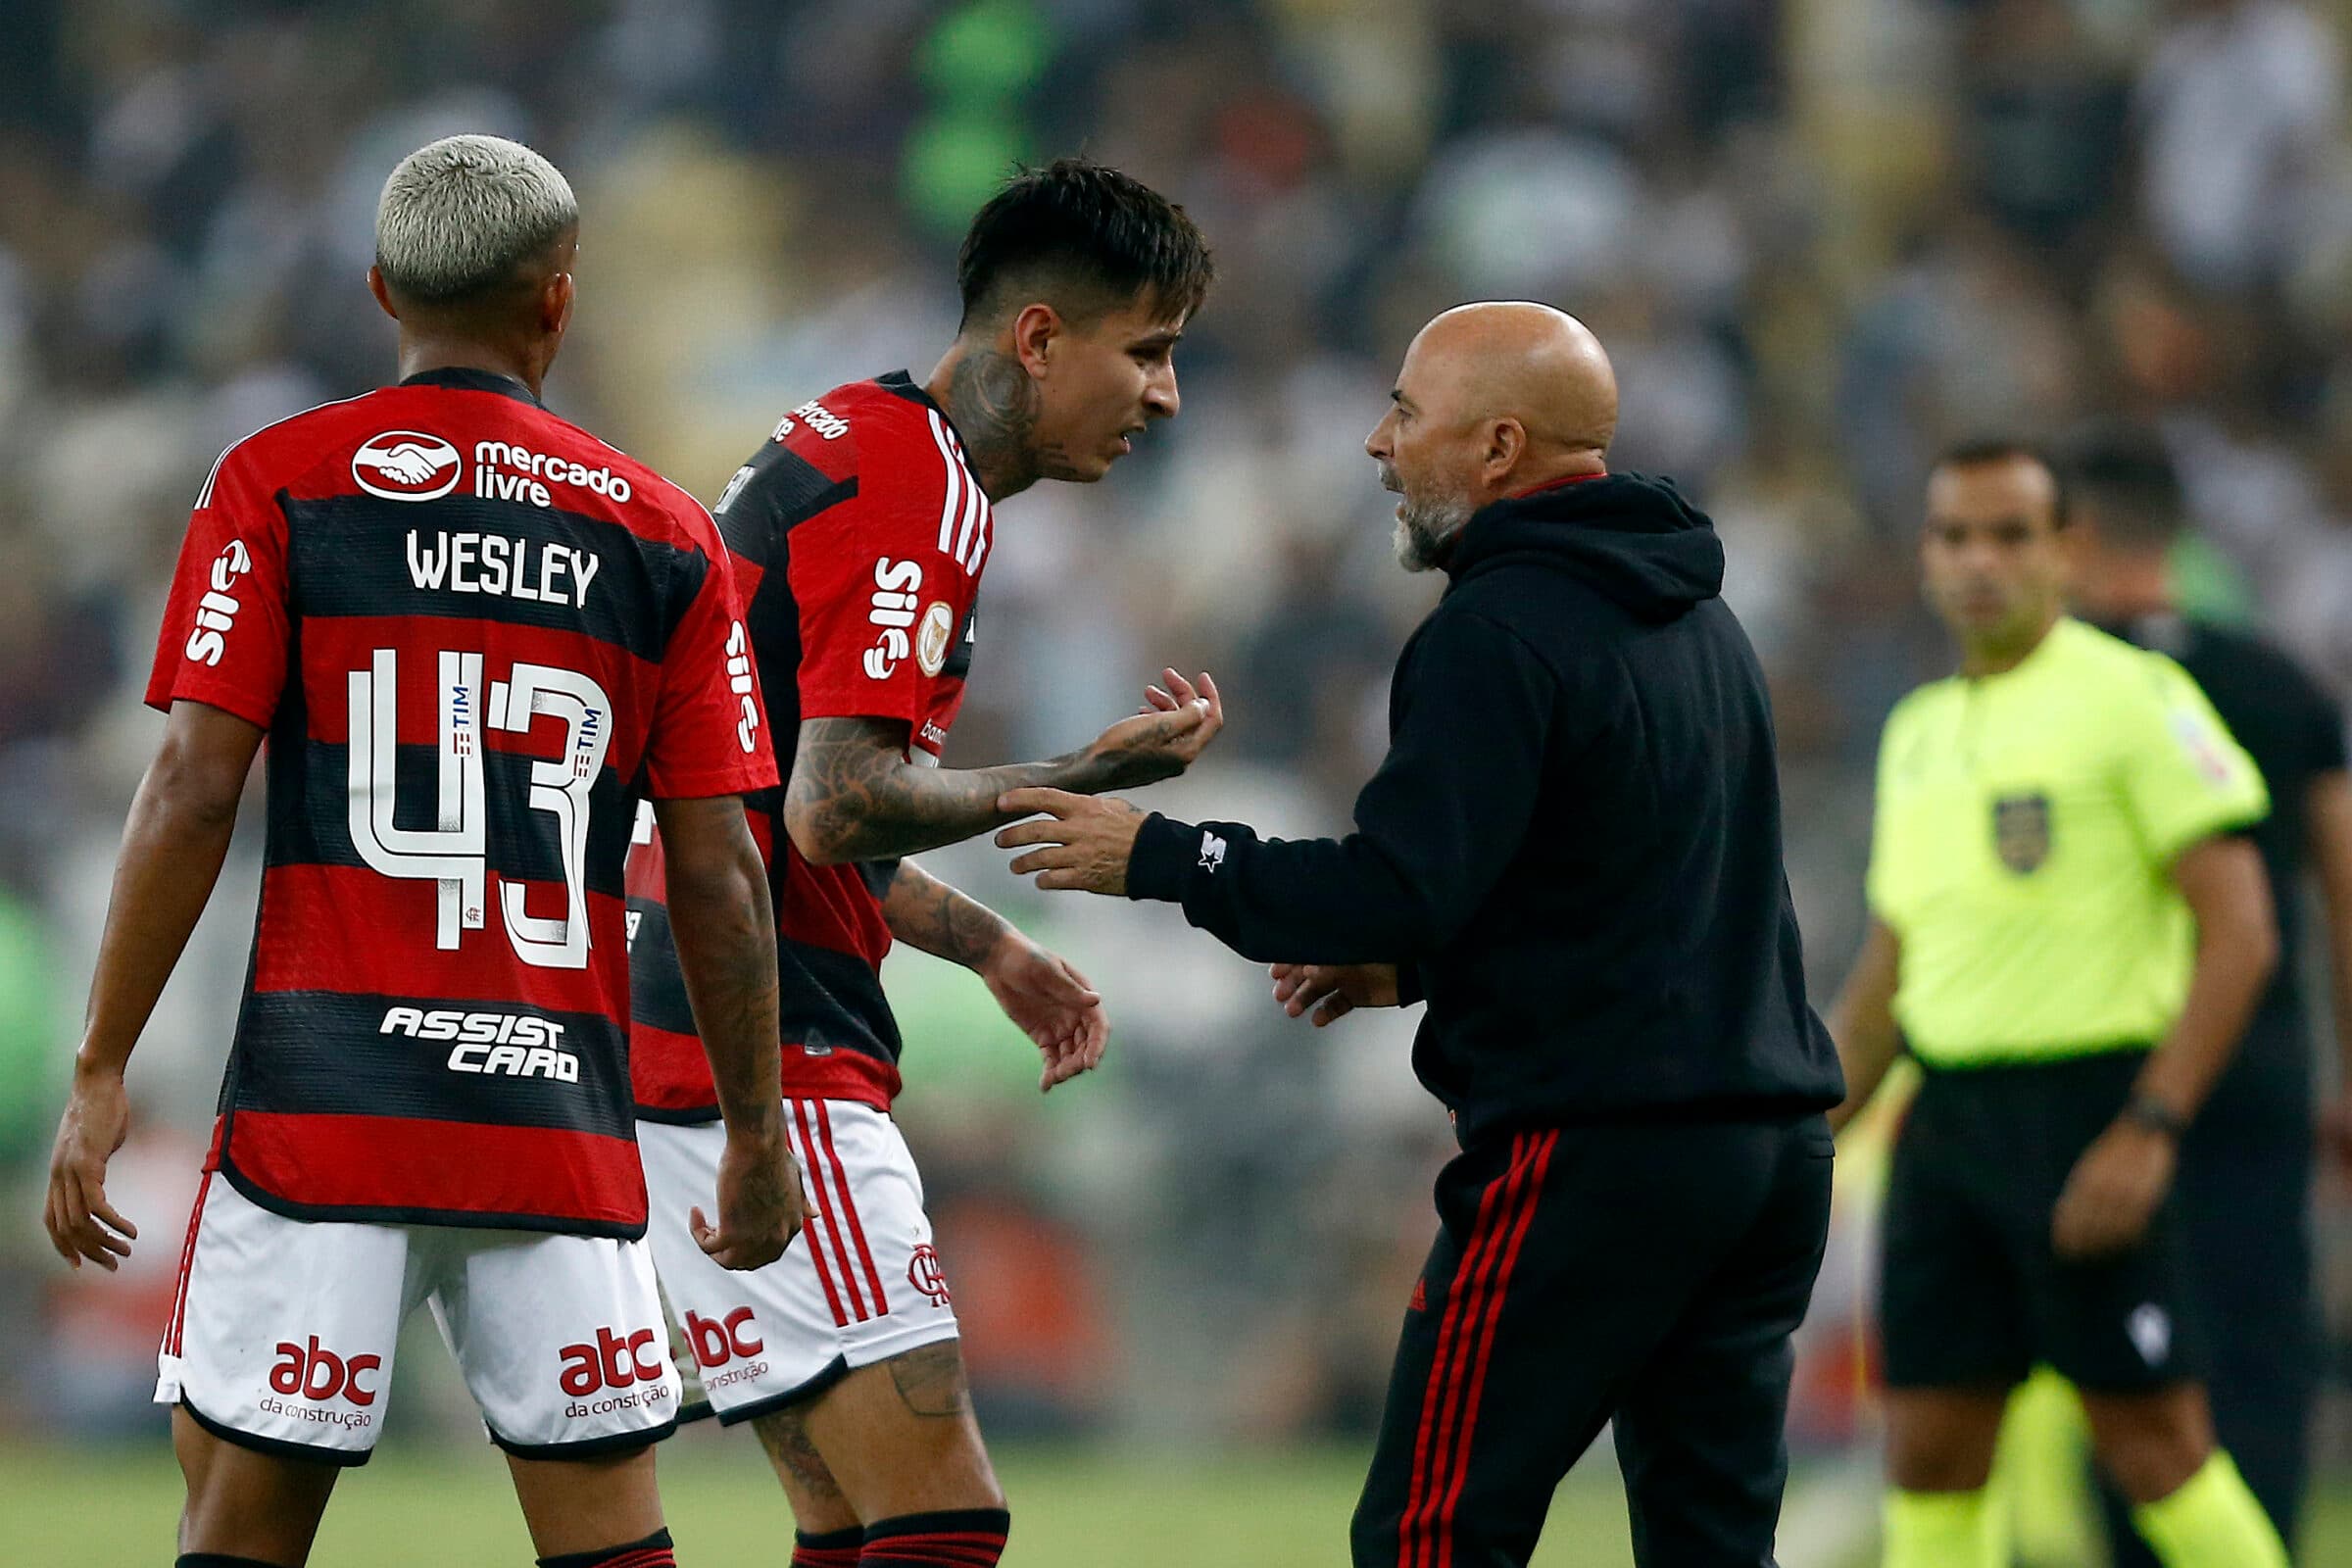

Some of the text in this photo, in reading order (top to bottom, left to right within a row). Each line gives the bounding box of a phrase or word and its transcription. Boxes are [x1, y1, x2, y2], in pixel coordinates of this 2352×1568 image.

[794, 399, 850, 440] ercado
[475, 441, 631, 503] mercado
[475, 464, 551, 508] livre
[407, 529, 599, 609] WESLEY
[453, 685, 469, 728] TIM
[577, 708, 602, 750] TIM
[348, 649, 612, 969] 43
[379, 1006, 564, 1050] ASSIST
[447, 1043, 580, 1083] CARD
[559, 1326, 663, 1397] abc
[681, 1306, 764, 1376] bc
[270, 1334, 382, 1406] abc
[260, 1396, 371, 1430] da construção
[564, 1401, 589, 1418] da
